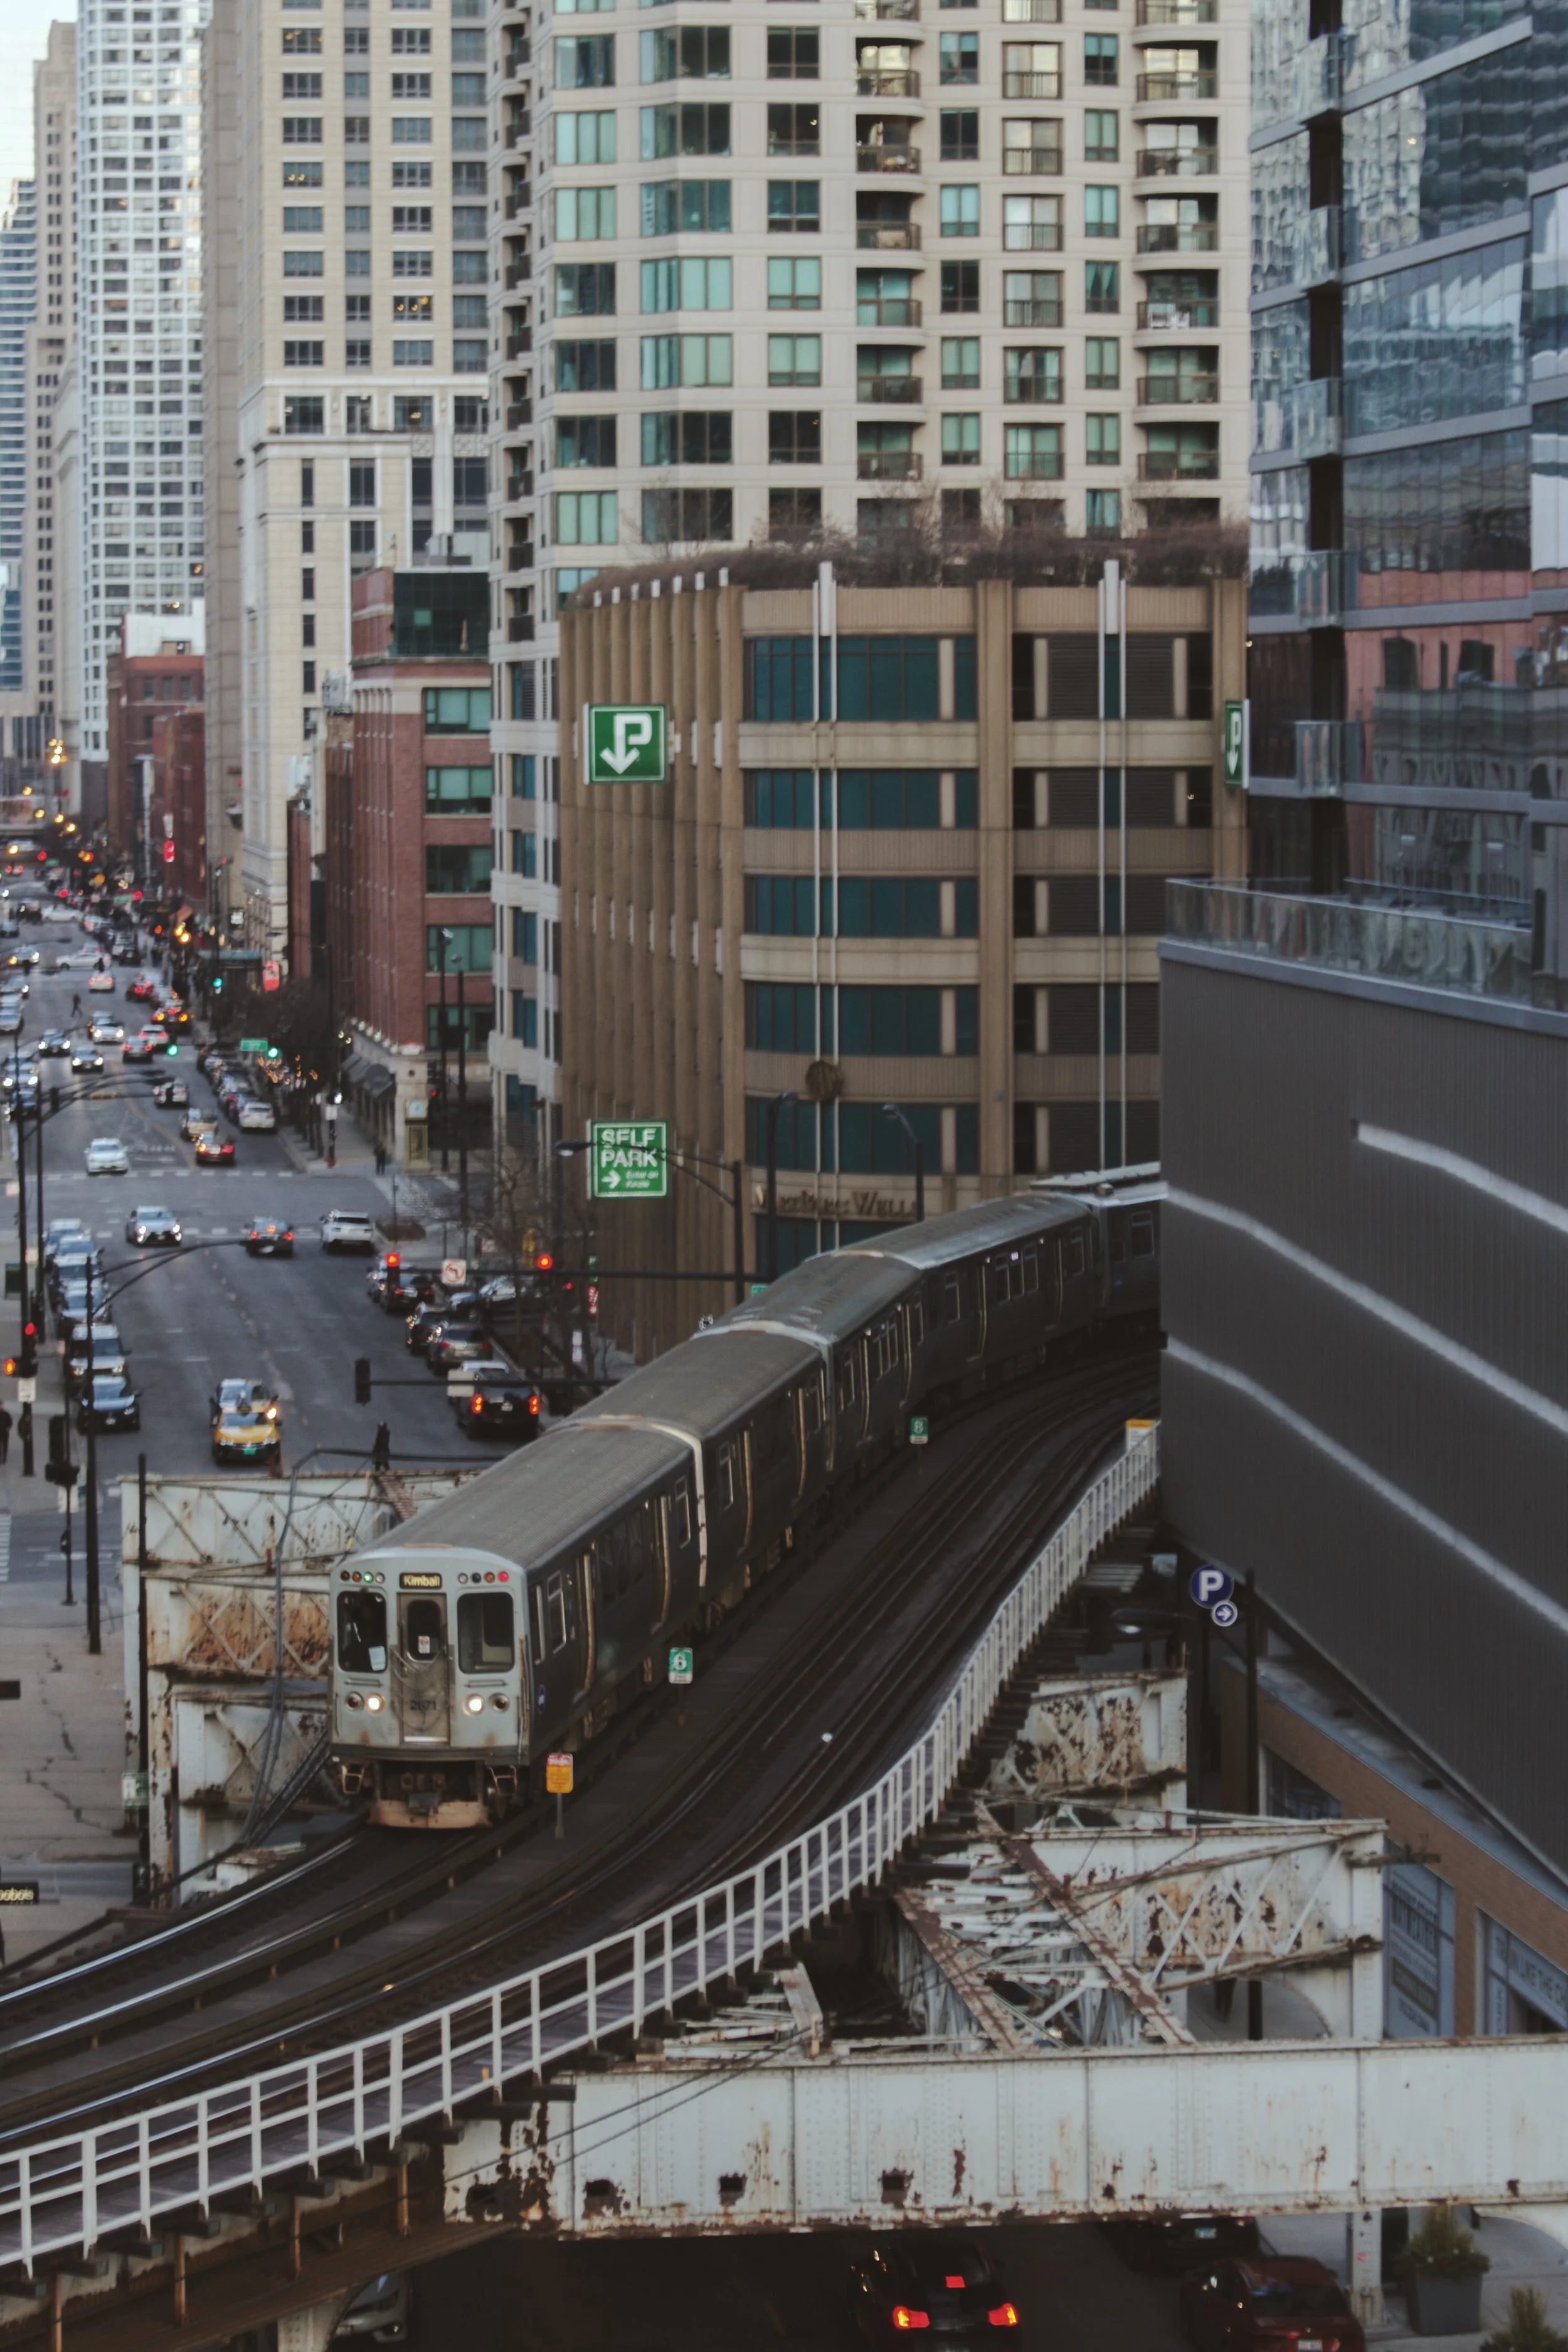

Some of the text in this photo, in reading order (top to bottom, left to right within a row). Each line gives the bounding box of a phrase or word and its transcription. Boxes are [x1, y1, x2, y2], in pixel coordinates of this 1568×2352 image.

[608, 712, 652, 763] P
[601, 1128, 656, 1148] SELF
[600, 1148, 657, 1168] PARK
[403, 1574, 440, 1587] Kimball
[1199, 1569, 1224, 1601] P
[673, 1651, 687, 1671] 6
